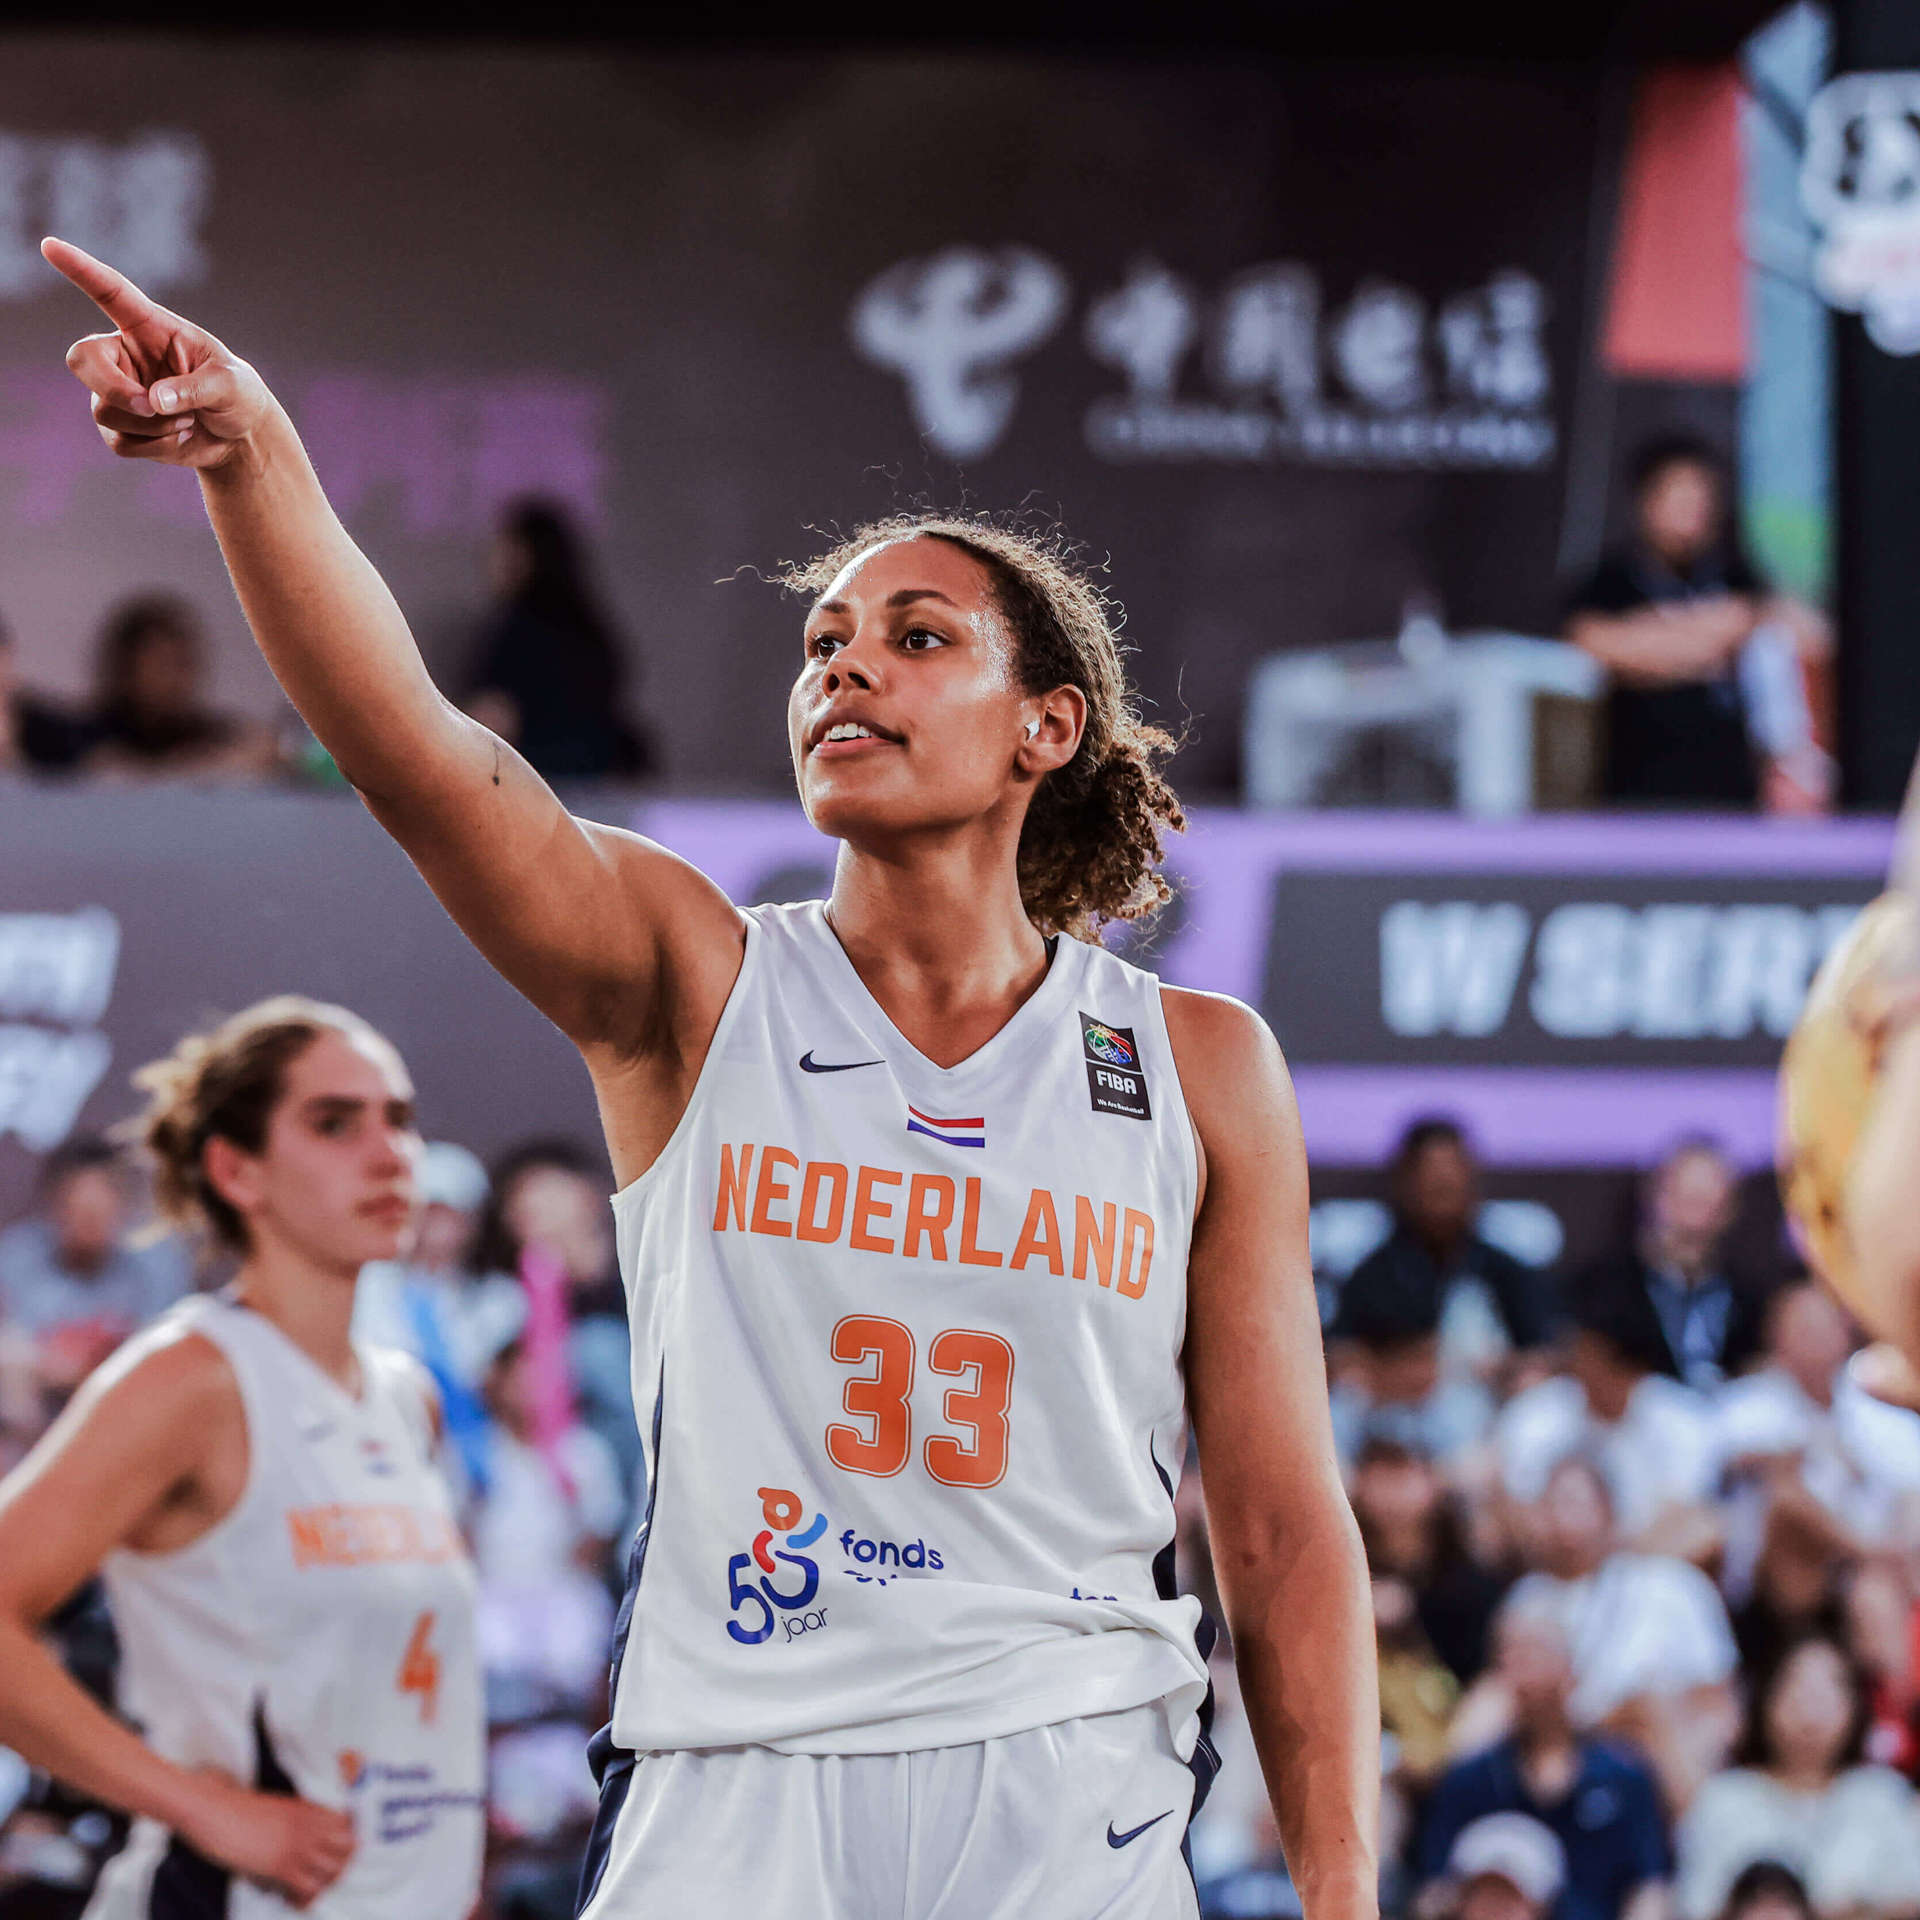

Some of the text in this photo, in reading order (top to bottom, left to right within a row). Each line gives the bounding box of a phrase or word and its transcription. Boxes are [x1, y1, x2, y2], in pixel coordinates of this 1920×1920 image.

[1095, 1069, 1137, 1095] FIBA
[713, 1143, 1155, 1300] NEDERLAND
[825, 1314, 1015, 1489] 33
[839, 1529, 945, 1570] fonds
[780, 1607, 828, 1644] jaar
[397, 1609, 443, 1728] 4
